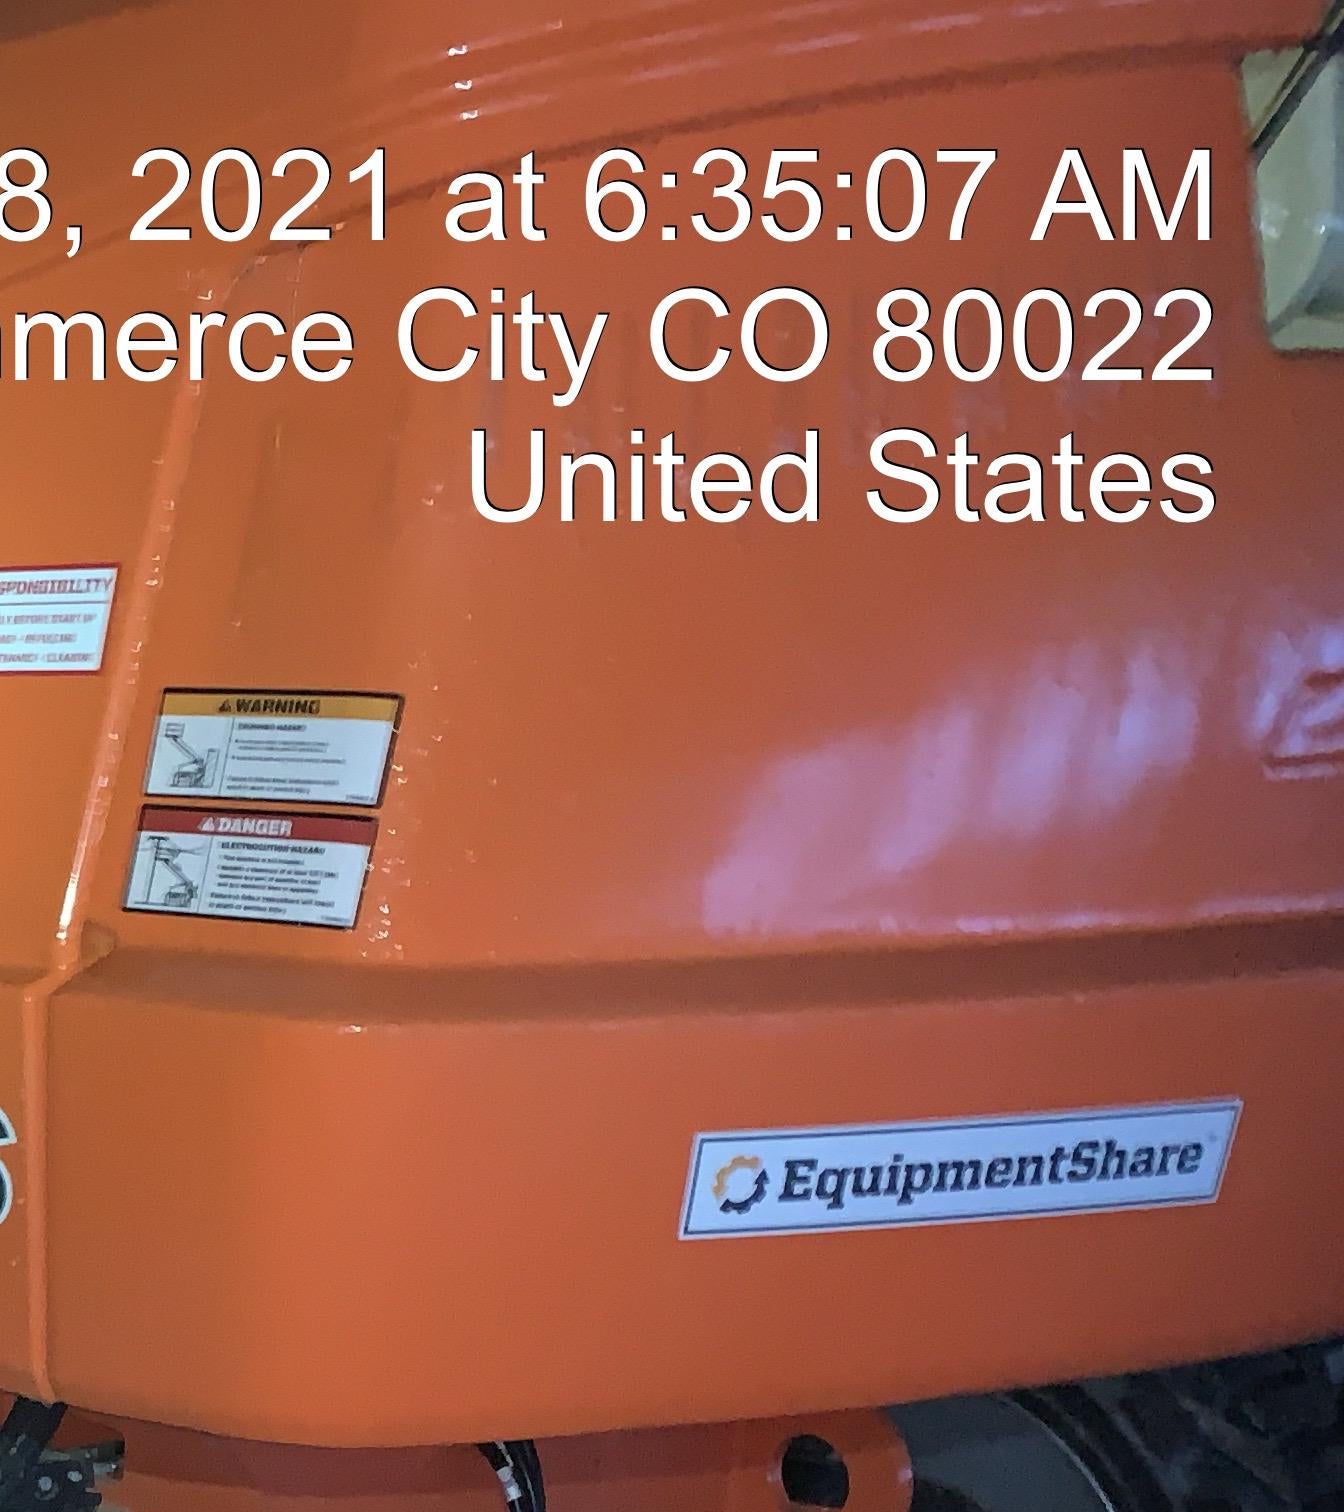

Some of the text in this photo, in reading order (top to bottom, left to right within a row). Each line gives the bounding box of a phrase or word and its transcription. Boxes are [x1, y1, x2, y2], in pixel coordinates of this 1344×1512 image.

[235, 698, 322, 715] WARNING
[217, 816, 293, 837] DANGER
[776, 1138, 1205, 1211] EquipmentShare
